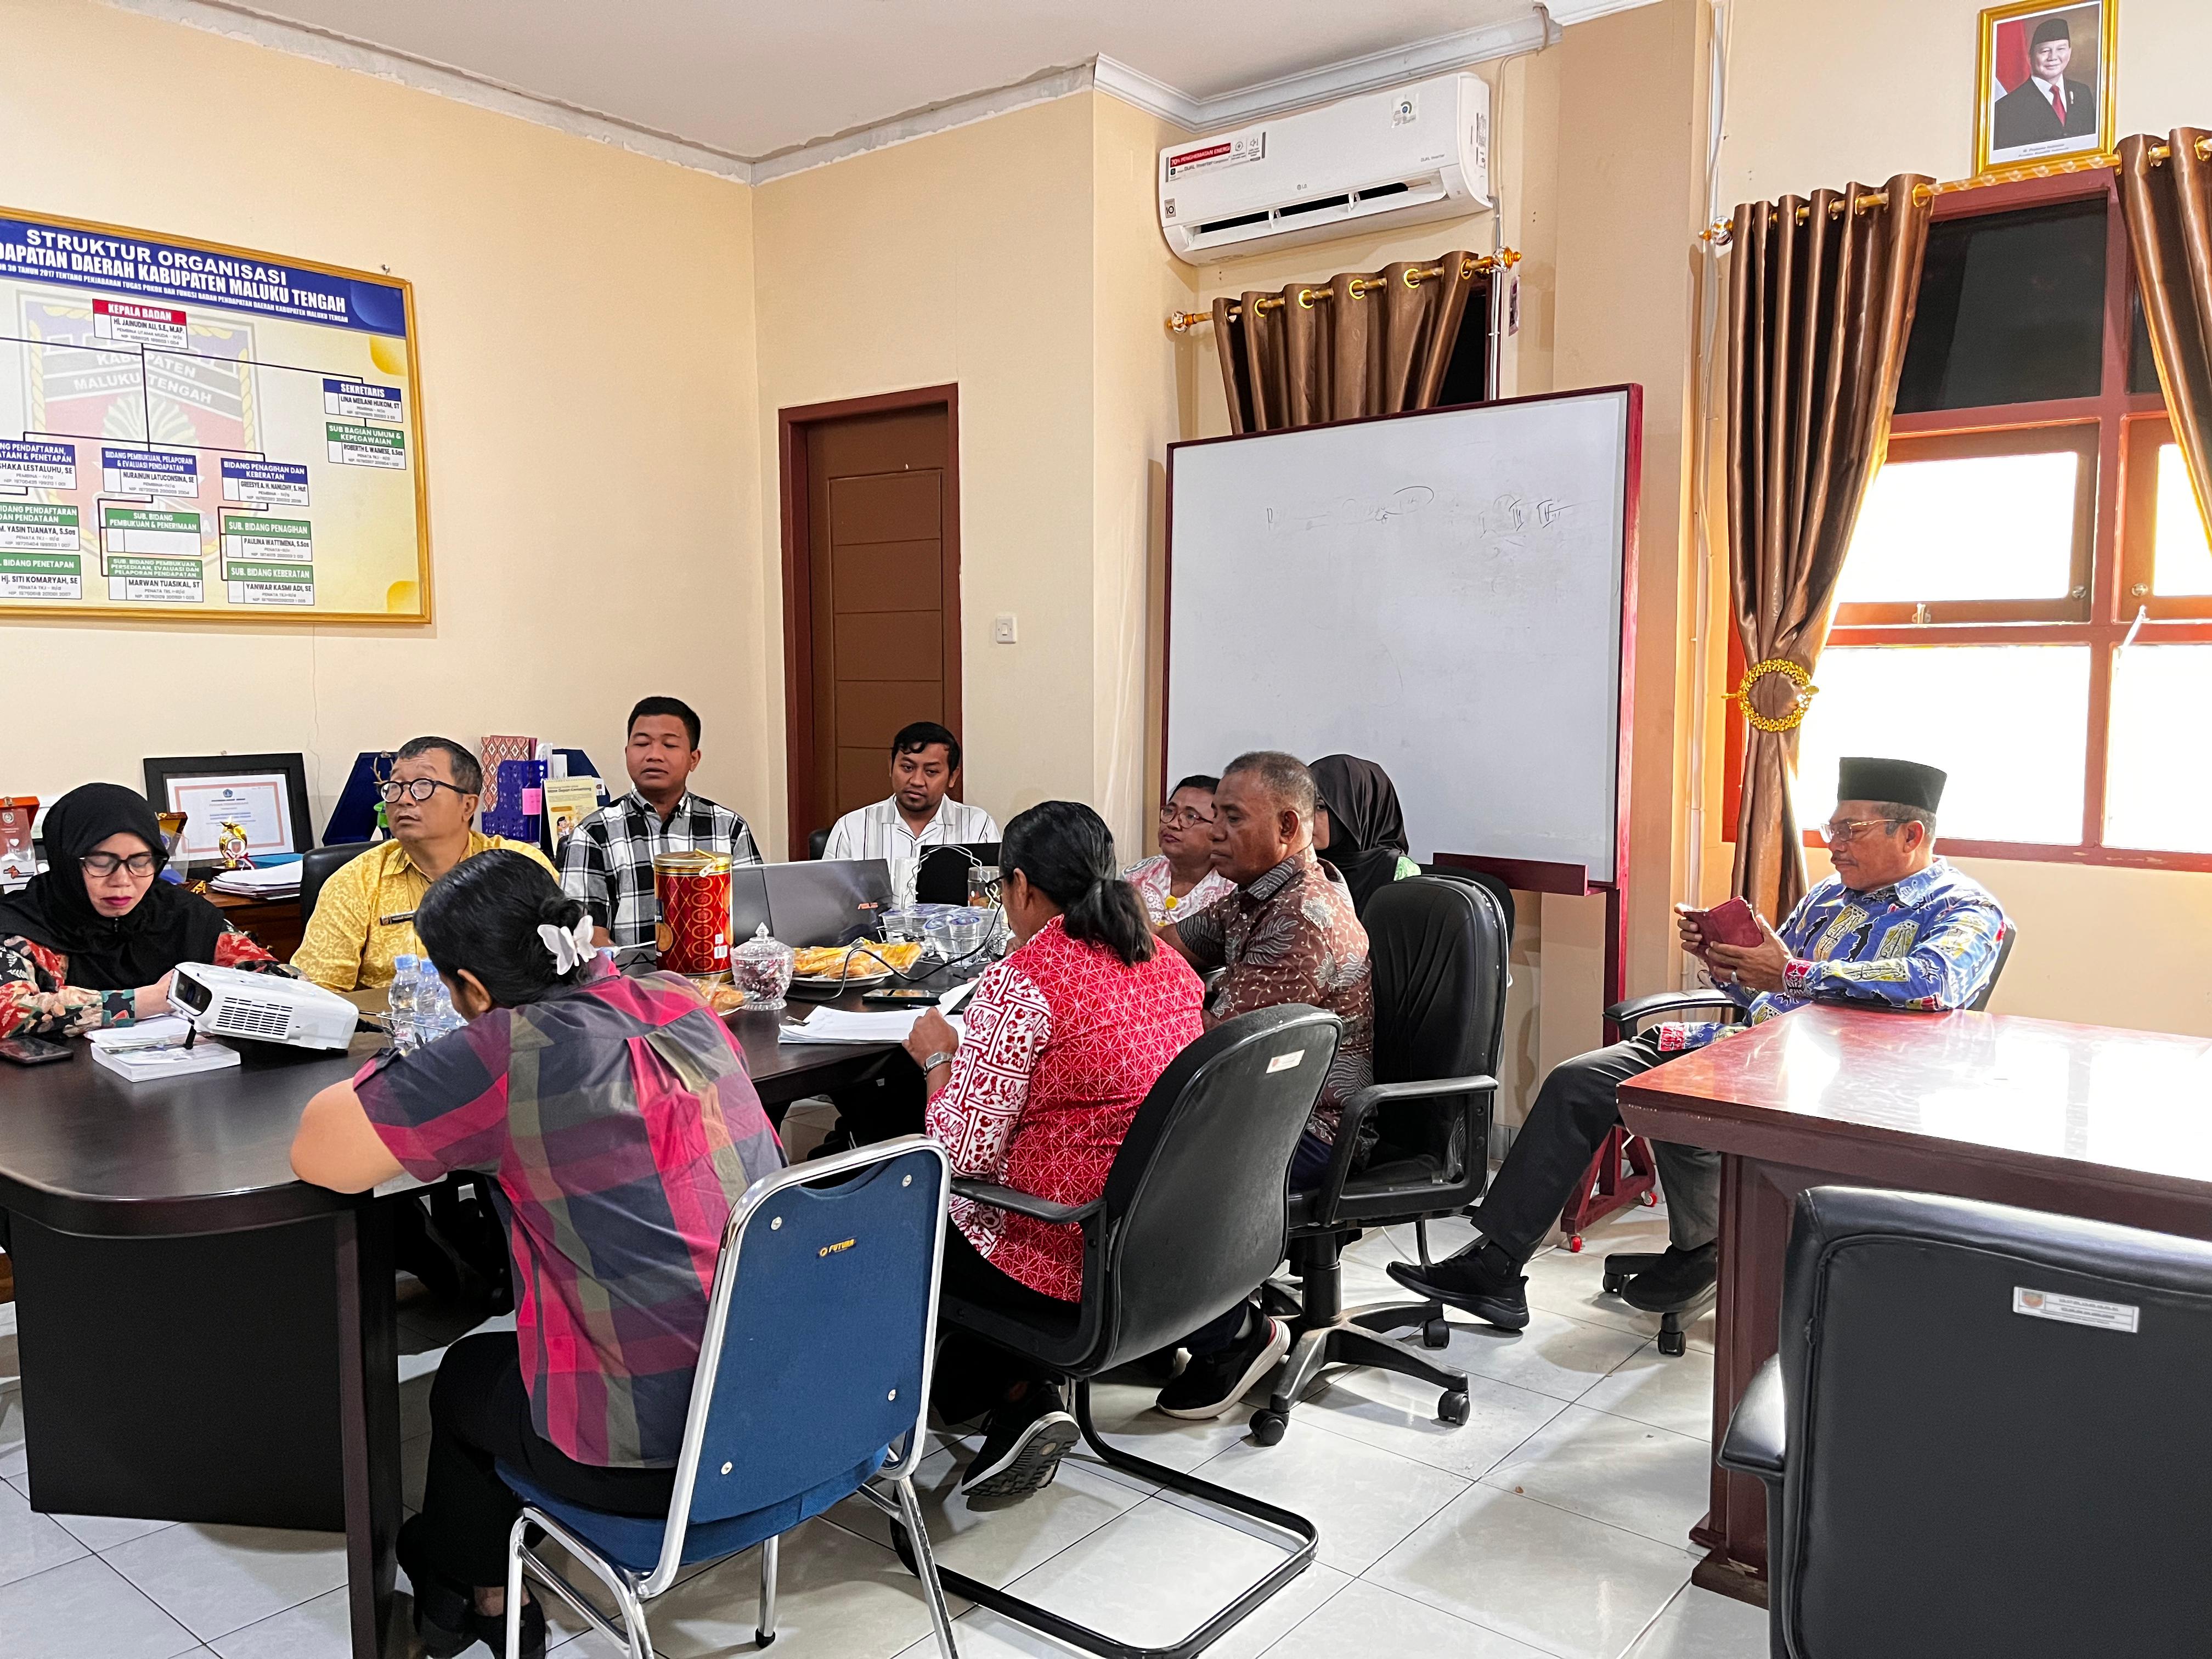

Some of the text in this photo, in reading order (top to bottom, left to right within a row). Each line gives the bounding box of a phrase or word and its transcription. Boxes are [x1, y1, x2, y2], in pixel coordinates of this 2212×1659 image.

[27, 229, 287, 286] STRUKTUR ORGANISASI
[71, 253, 135, 279] DAERAH
[138, 263, 226, 294] KABUPATEN
[229, 278, 289, 303] MALUKU
[292, 289, 346, 313] TENGAH
[18, 266, 38, 275] TAHUN
[40, 269, 54, 278] 2017
[55, 270, 83, 281] TENTANG
[83, 275, 122, 287] PENJABARAN
[122, 280, 142, 291] TUGAS
[143, 284, 163, 294] POKOK
[163, 286, 176, 295] DAN
[176, 290, 197, 299] FUNGSI
[198, 292, 217, 302] BADAN
[218, 295, 253, 308] PENDAPATAN
[253, 301, 275, 311] DAERAH
[275, 304, 306, 317] KABUPATEN
[306, 310, 328, 320] MALUKU
[329, 314, 348, 323] TENGAH
[108, 303, 172, 322] KEPALA BADAN
[122, 319, 148, 329] JAINUDIN
[96, 352, 196, 379] KABUPATEN
[74, 371, 212, 405] MALUKU TENGAH
[340, 383, 385, 398] SEKRETARIS
[329, 425, 343, 433] SUB
[344, 426, 373, 436] BAGIAN
[373, 429, 395, 439] UMUM
[340, 433, 392, 445] KEPEGAWAIAN
[12, 443, 66, 455] PENDAFTARAN,
[31, 453, 72, 463] PENETAPAN
[105, 451, 126, 459] BIDANG
[162, 456, 193, 465] PELAPORAN
[24, 464, 64, 475] LESTALUHU,
[122, 461, 148, 469] EVALUASI
[148, 463, 184, 472] PENDAPATAN
[223, 461, 304, 475] BIDANG PENAGIHAN DAN
[246, 471, 285, 481] KEBERATAN
[25, 506, 77, 516] PENDAFTARAN
[15, 514, 59, 523] PENDATAAN
[149, 513, 173, 522] BIDANG
[109, 519, 150, 528] PEMBUKUAN
[157, 522, 197, 531] PENERIMAAN
[228, 521, 308, 534] SUB. BIDANG PENAGIHAN
[27, 527, 58, 536] TUANAYA,
[3, 558, 75, 568] BIDANG PENETAPAN
[231, 567, 310, 579] SUB. BIDANG KEBERATAN
[26, 577, 69, 585] KOMARYAH,
[160, 580, 191, 588] TUASIKAL,
